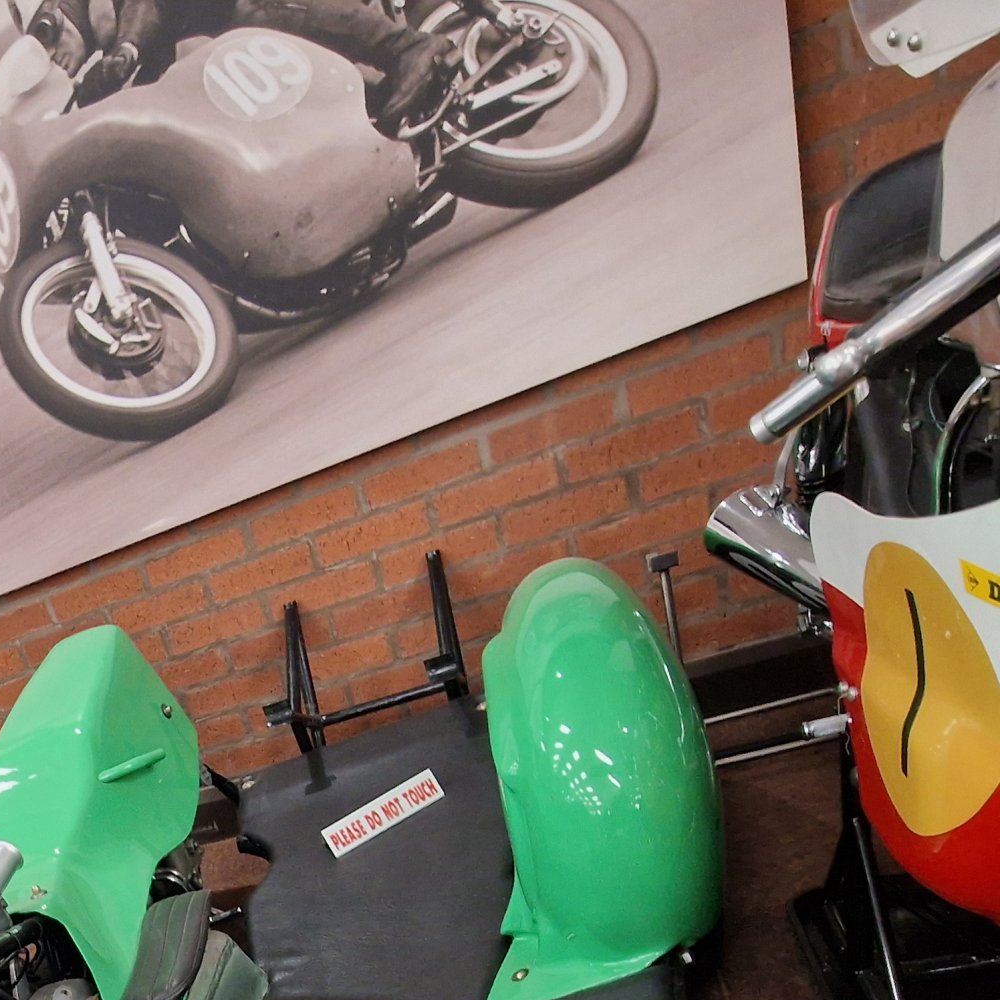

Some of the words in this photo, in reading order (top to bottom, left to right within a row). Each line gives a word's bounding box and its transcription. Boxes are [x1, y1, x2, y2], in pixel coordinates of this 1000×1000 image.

[206, 37, 308, 116] 109
[330, 820, 367, 850] PLEASE
[364, 810, 383, 831] DO
[381, 797, 404, 821] NOT
[402, 778, 438, 808] TOUCH
